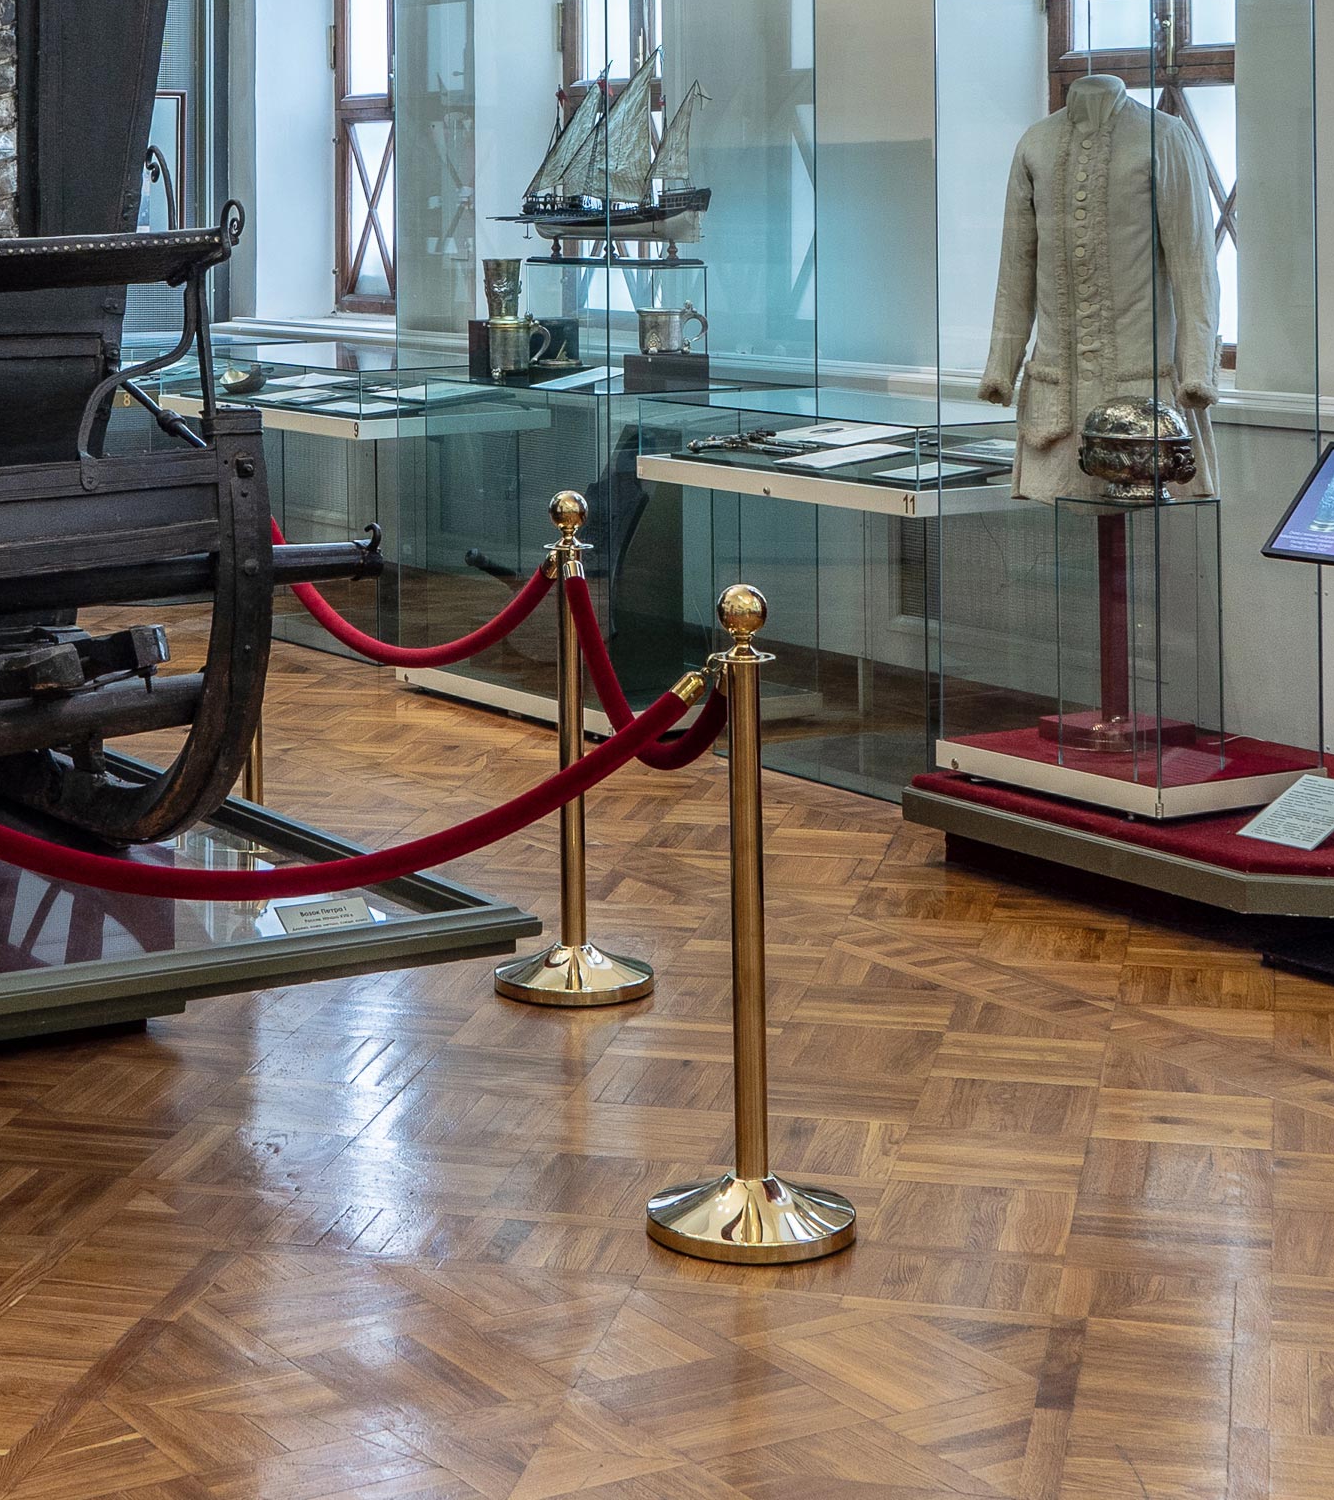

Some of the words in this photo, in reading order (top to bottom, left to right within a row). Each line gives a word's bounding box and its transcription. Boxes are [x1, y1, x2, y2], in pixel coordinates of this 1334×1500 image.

[123, 393, 131, 407] 8
[353, 422, 359, 438] 9
[903, 494, 915, 515] 11
[299, 910, 320, 918] Возок
[321, 907, 343, 915] Петра
